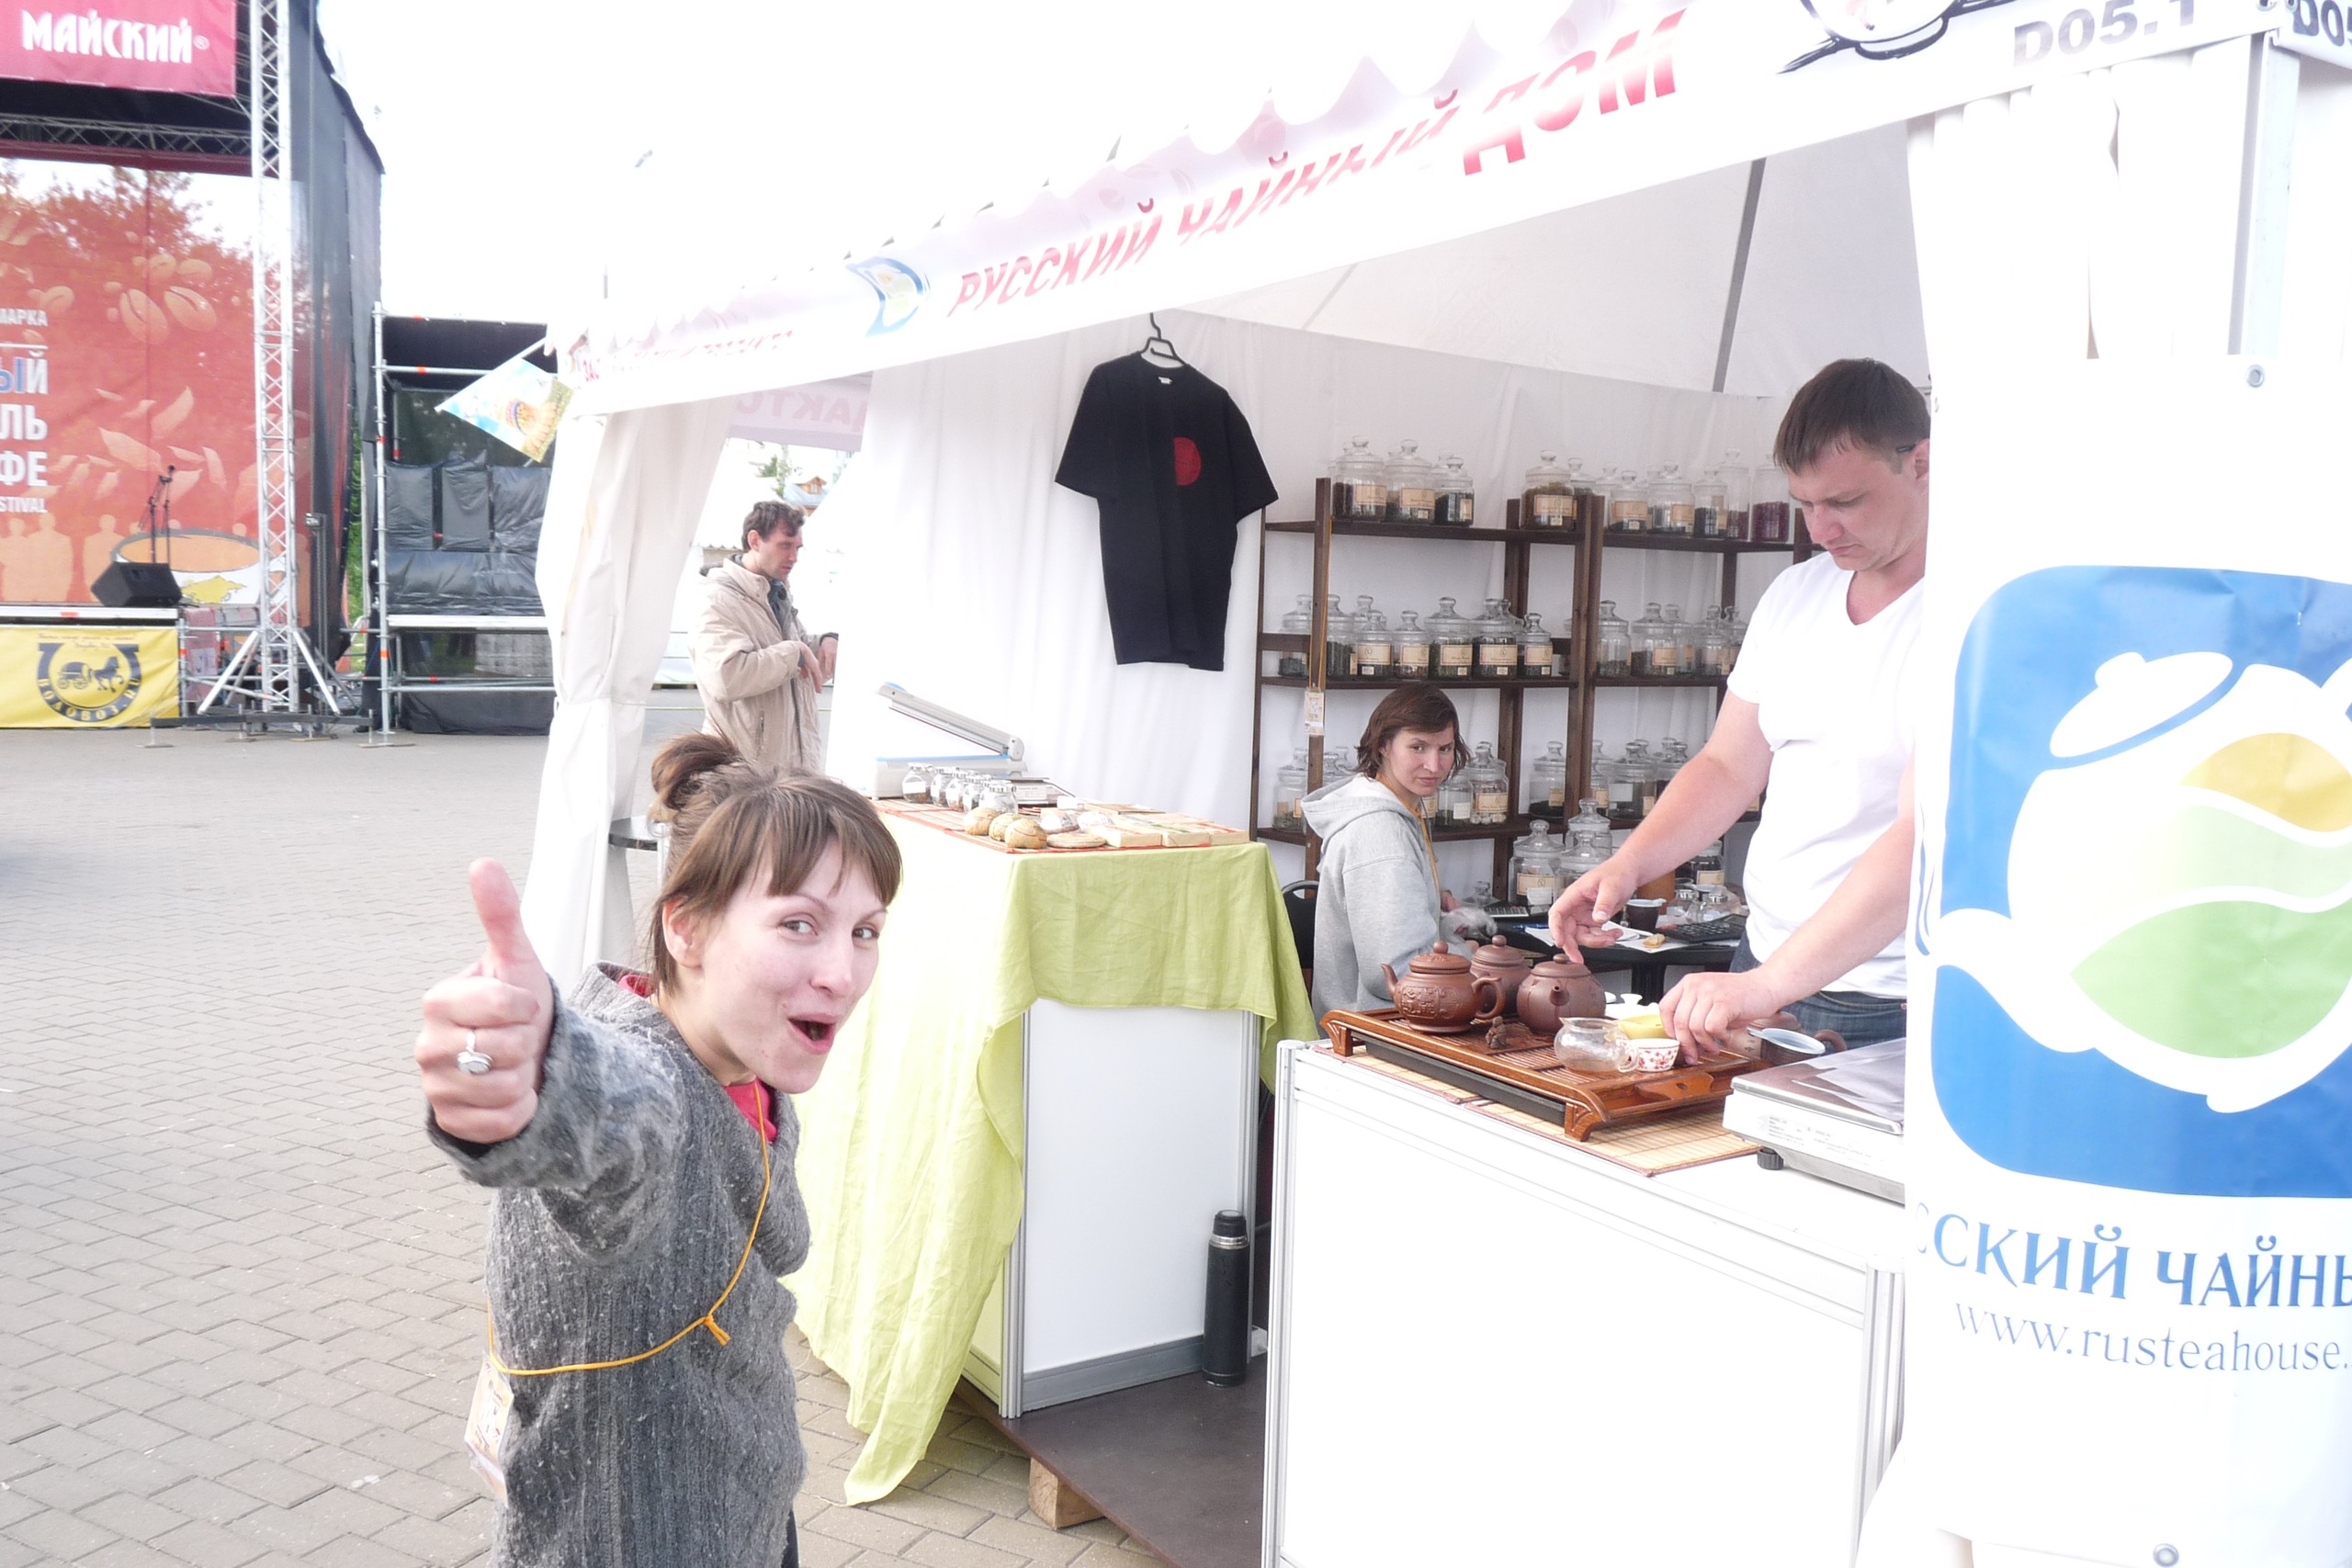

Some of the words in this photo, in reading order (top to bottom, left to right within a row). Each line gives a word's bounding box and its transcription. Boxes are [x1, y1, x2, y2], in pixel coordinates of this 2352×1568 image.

[22, 9, 192, 64] МАЙСКИЙ
[2293, 0, 2352, 47] D0
[946, 197, 1163, 318] РУССКИЙ
[1177, 88, 1461, 246] ЧАЙНЫЙ
[1463, 7, 1688, 176] ДОМ
[1955, 1303, 2352, 1371] www.rusteahouse.
